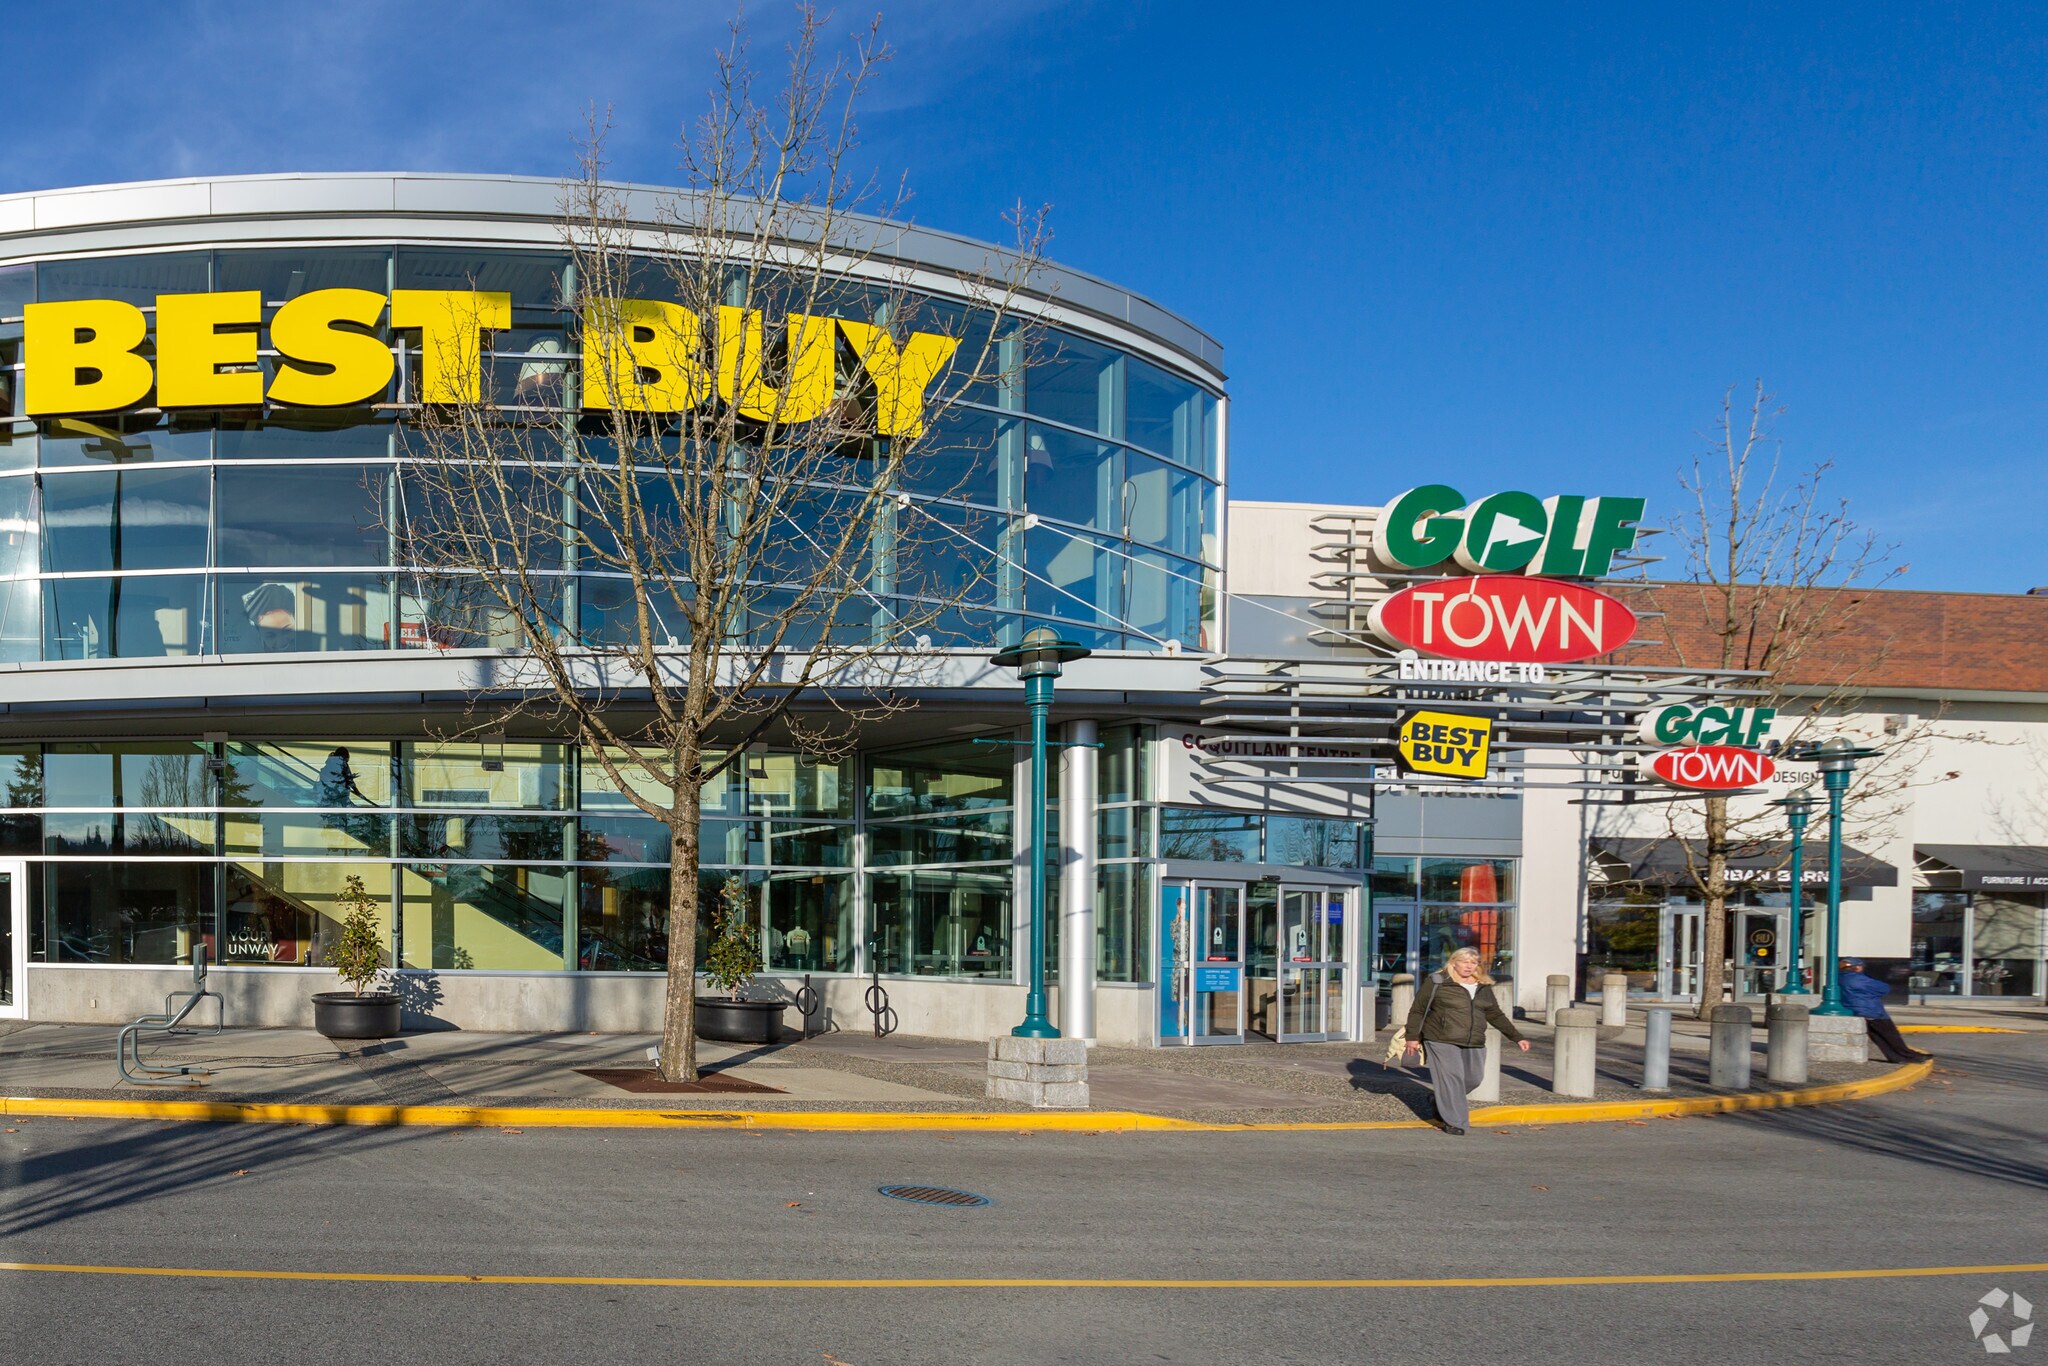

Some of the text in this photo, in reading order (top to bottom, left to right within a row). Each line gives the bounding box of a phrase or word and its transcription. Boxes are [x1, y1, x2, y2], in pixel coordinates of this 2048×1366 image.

[24, 287, 963, 439] BEST BUY
[1385, 484, 1646, 577] GOLF
[1413, 591, 1603, 653] TOWN
[1400, 659, 1544, 684] ENTRANCE TO
[1411, 722, 1487, 748] BEST
[1655, 705, 1777, 745] GOLF
[1412, 742, 1479, 767] BUY
[1668, 752, 1763, 783] TOWN
[1773, 771, 1819, 783] DESIGN
[1703, 869, 1830, 882] RBAN BRN
[1982, 876, 2025, 885] FURNITURE
[229, 930, 269, 942] YOUR
[228, 943, 279, 955] UNWAY
